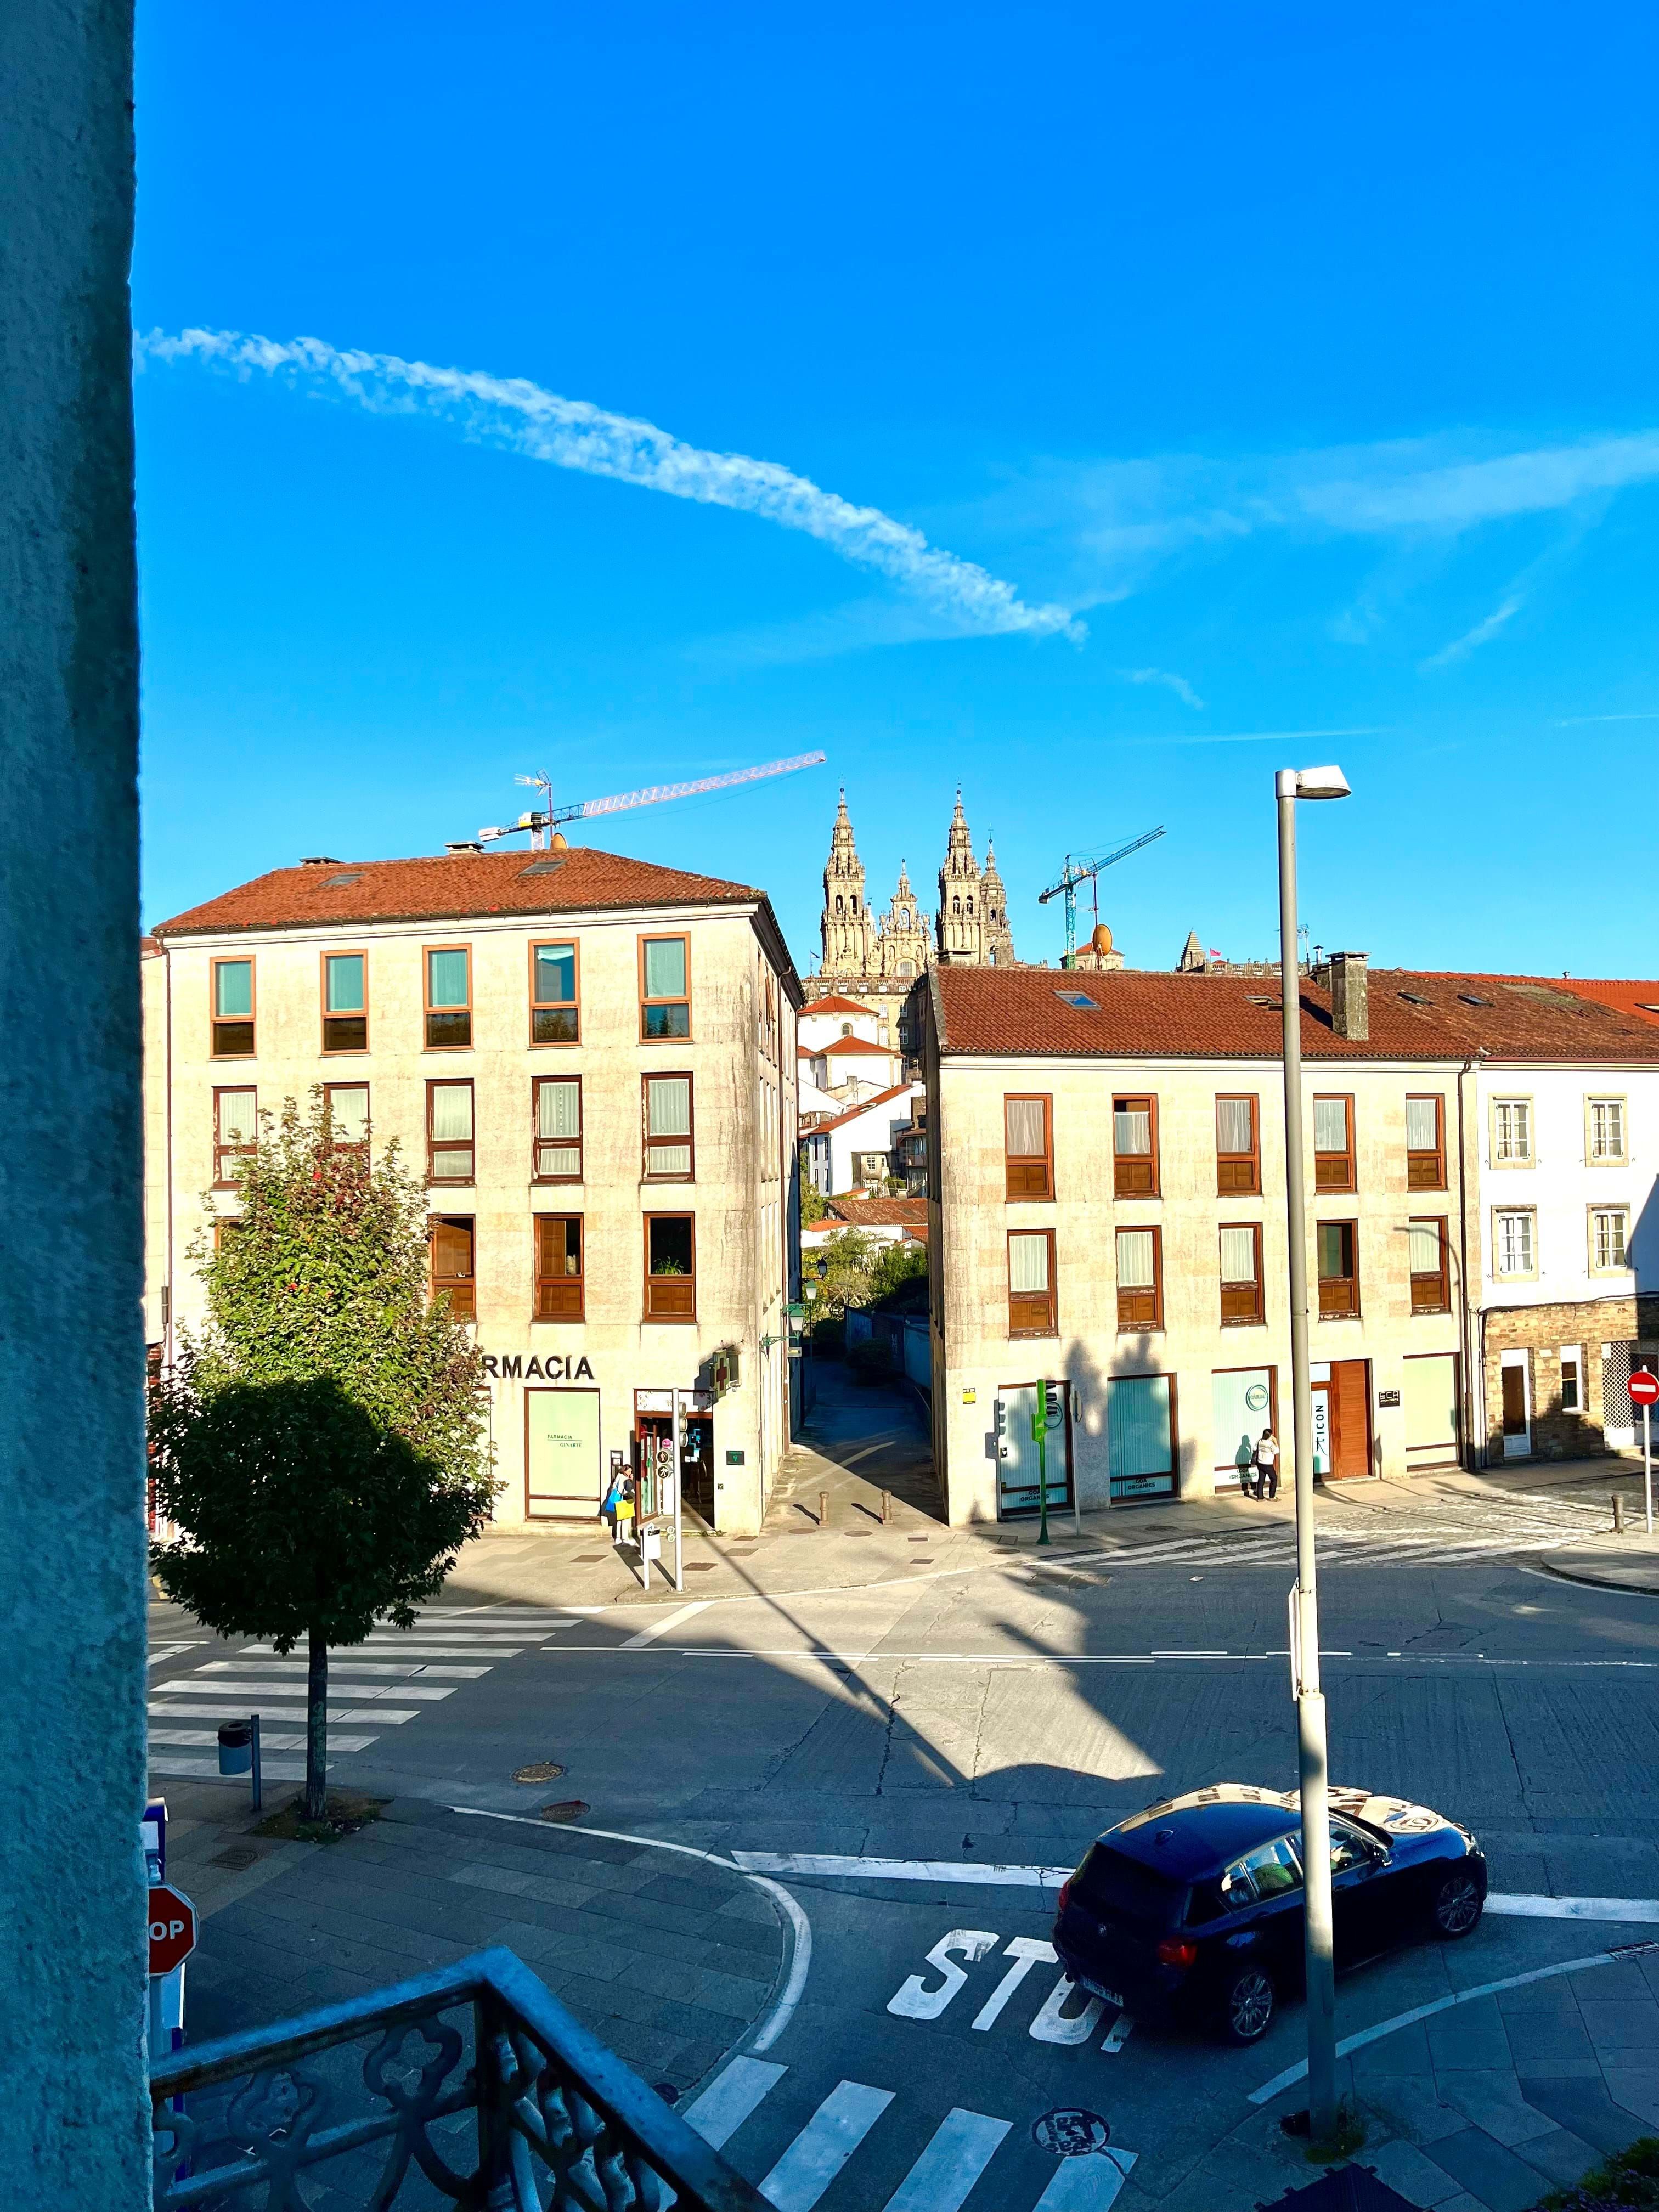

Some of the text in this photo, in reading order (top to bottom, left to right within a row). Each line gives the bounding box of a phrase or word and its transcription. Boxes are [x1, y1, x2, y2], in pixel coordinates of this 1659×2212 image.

[482, 1355, 595, 1379] RMACIA
[1020, 1493, 1050, 1502] ORGANS
[149, 1920, 184, 1940] OP
